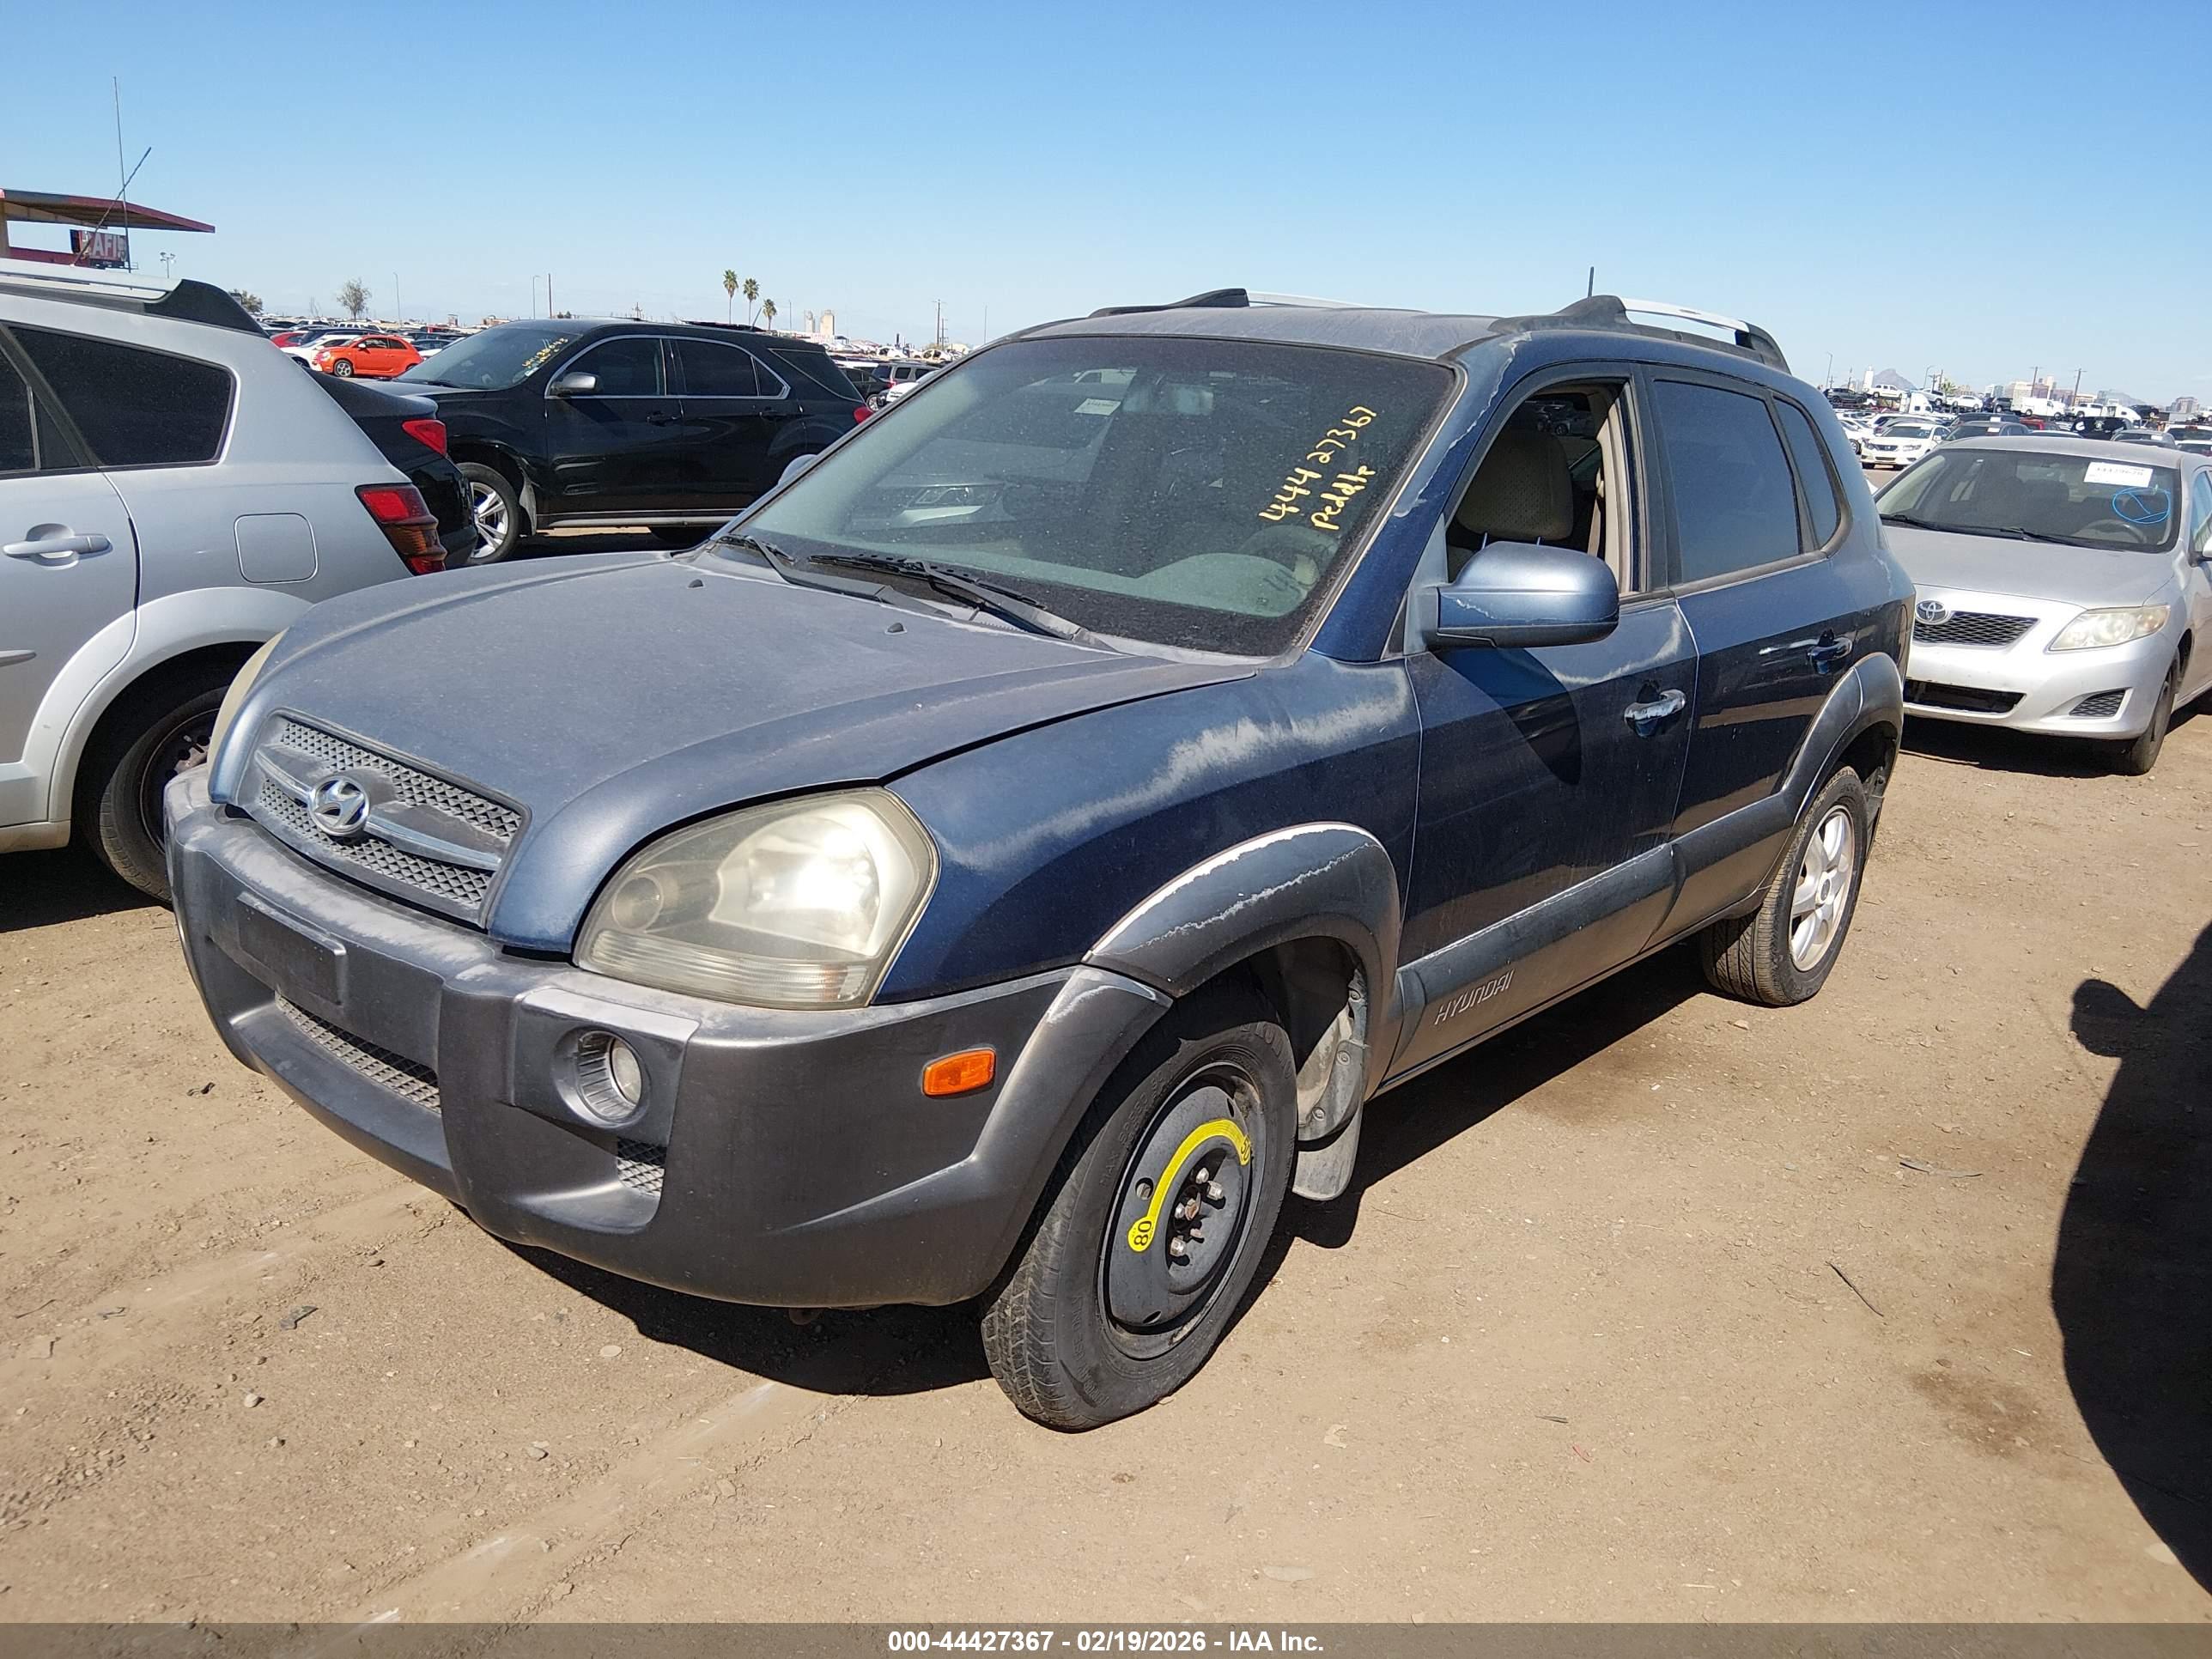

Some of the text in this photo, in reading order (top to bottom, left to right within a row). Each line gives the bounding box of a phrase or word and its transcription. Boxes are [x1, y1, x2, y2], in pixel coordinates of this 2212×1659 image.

[1258, 405, 1376, 520] 444 27367
[1434, 968, 1515, 1025] HYUNDAI
[1133, 1220, 1152, 1246] 80
